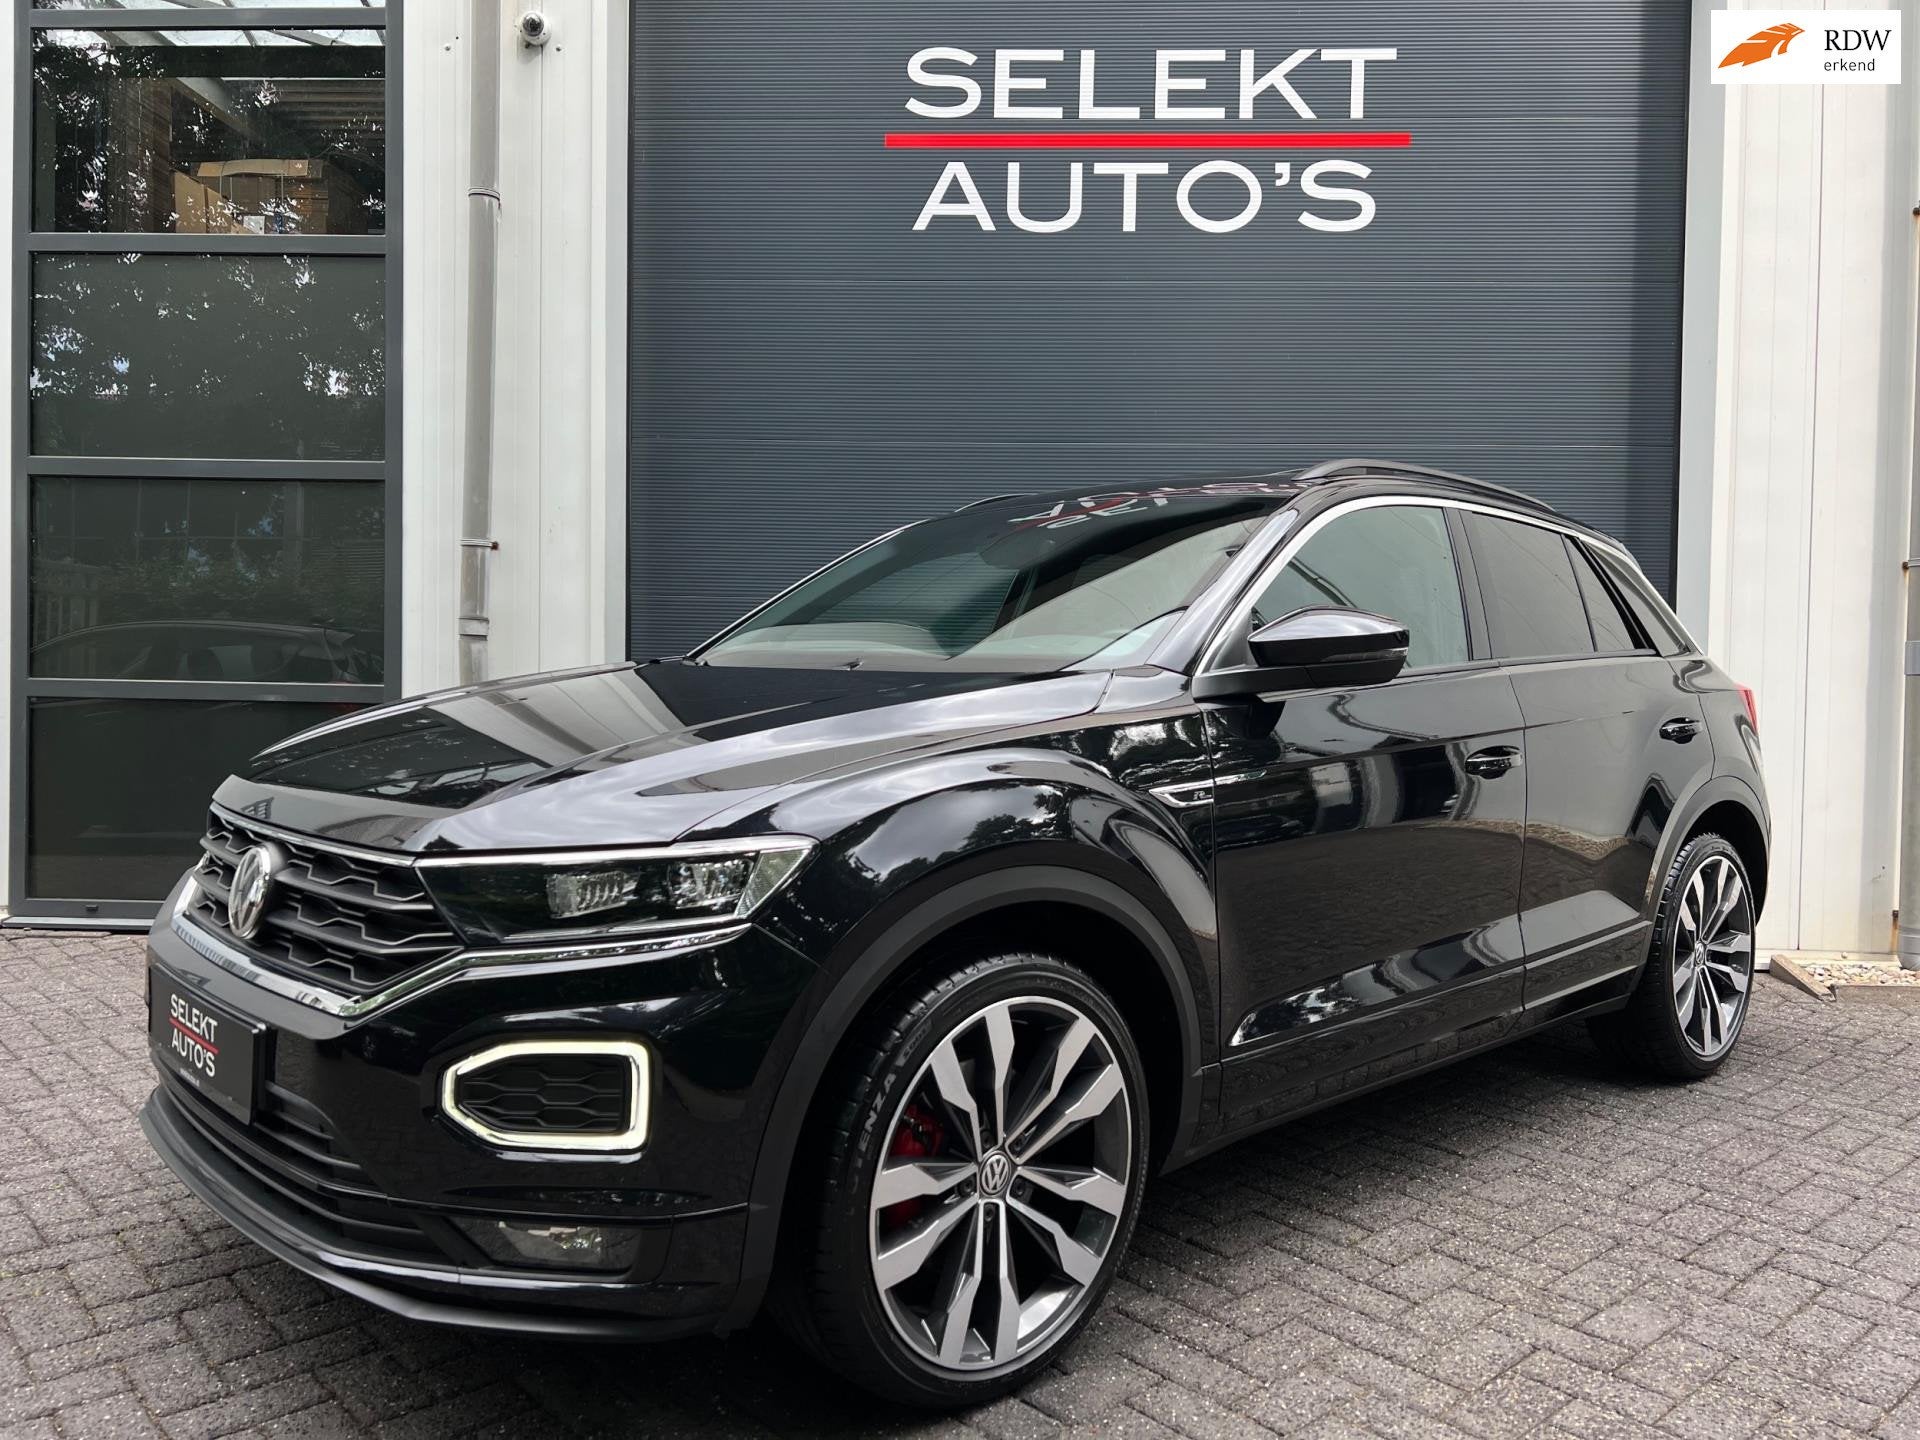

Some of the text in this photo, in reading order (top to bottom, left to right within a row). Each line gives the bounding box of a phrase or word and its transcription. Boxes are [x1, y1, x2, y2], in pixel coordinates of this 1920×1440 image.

[904, 46, 1398, 119] SELEKT
[912, 159, 1377, 233] AUTO'S
[170, 993, 218, 1043] SELEKT
[171, 1027, 216, 1077] AUTO'S
